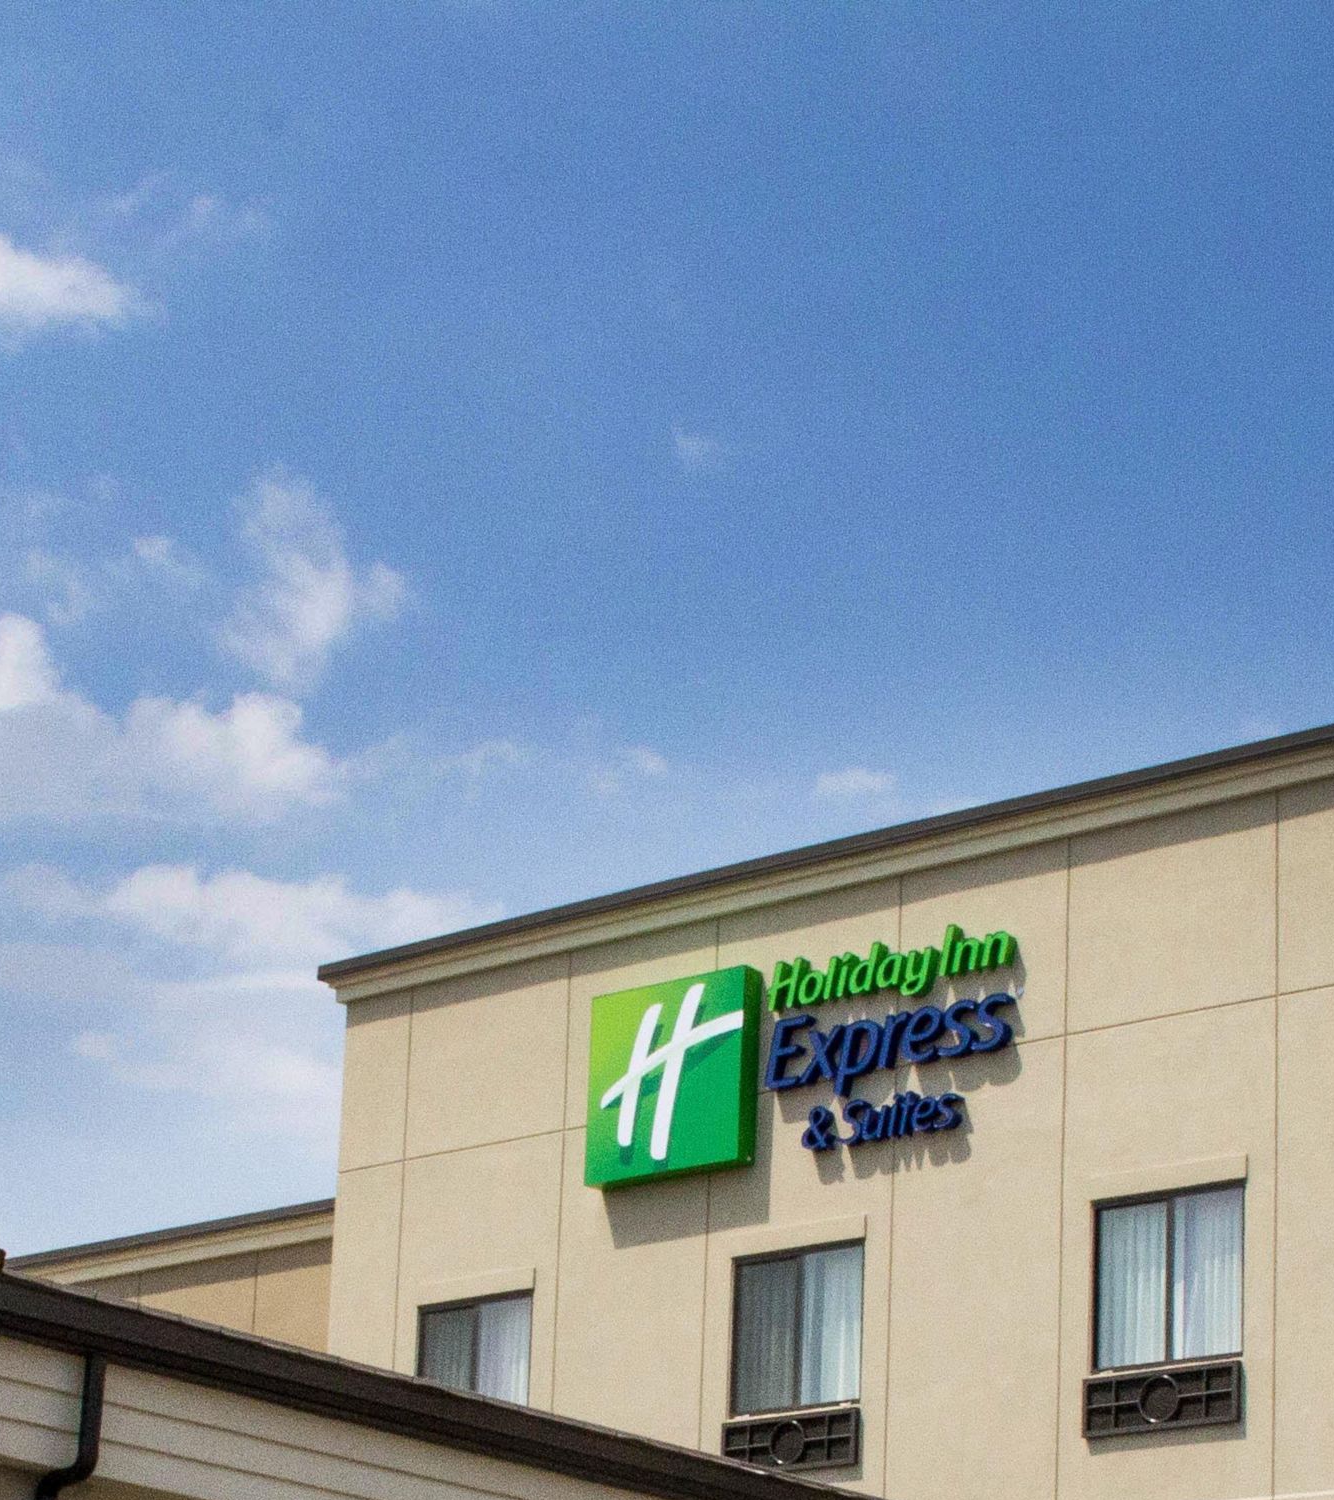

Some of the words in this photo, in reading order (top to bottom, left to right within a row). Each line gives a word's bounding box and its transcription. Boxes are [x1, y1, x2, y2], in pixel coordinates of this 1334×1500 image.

[768, 941, 940, 1012] Holiday
[939, 923, 1017, 978] Inn
[765, 992, 1017, 1097] Express
[801, 1105, 838, 1150] &
[836, 1091, 966, 1146] Suites
